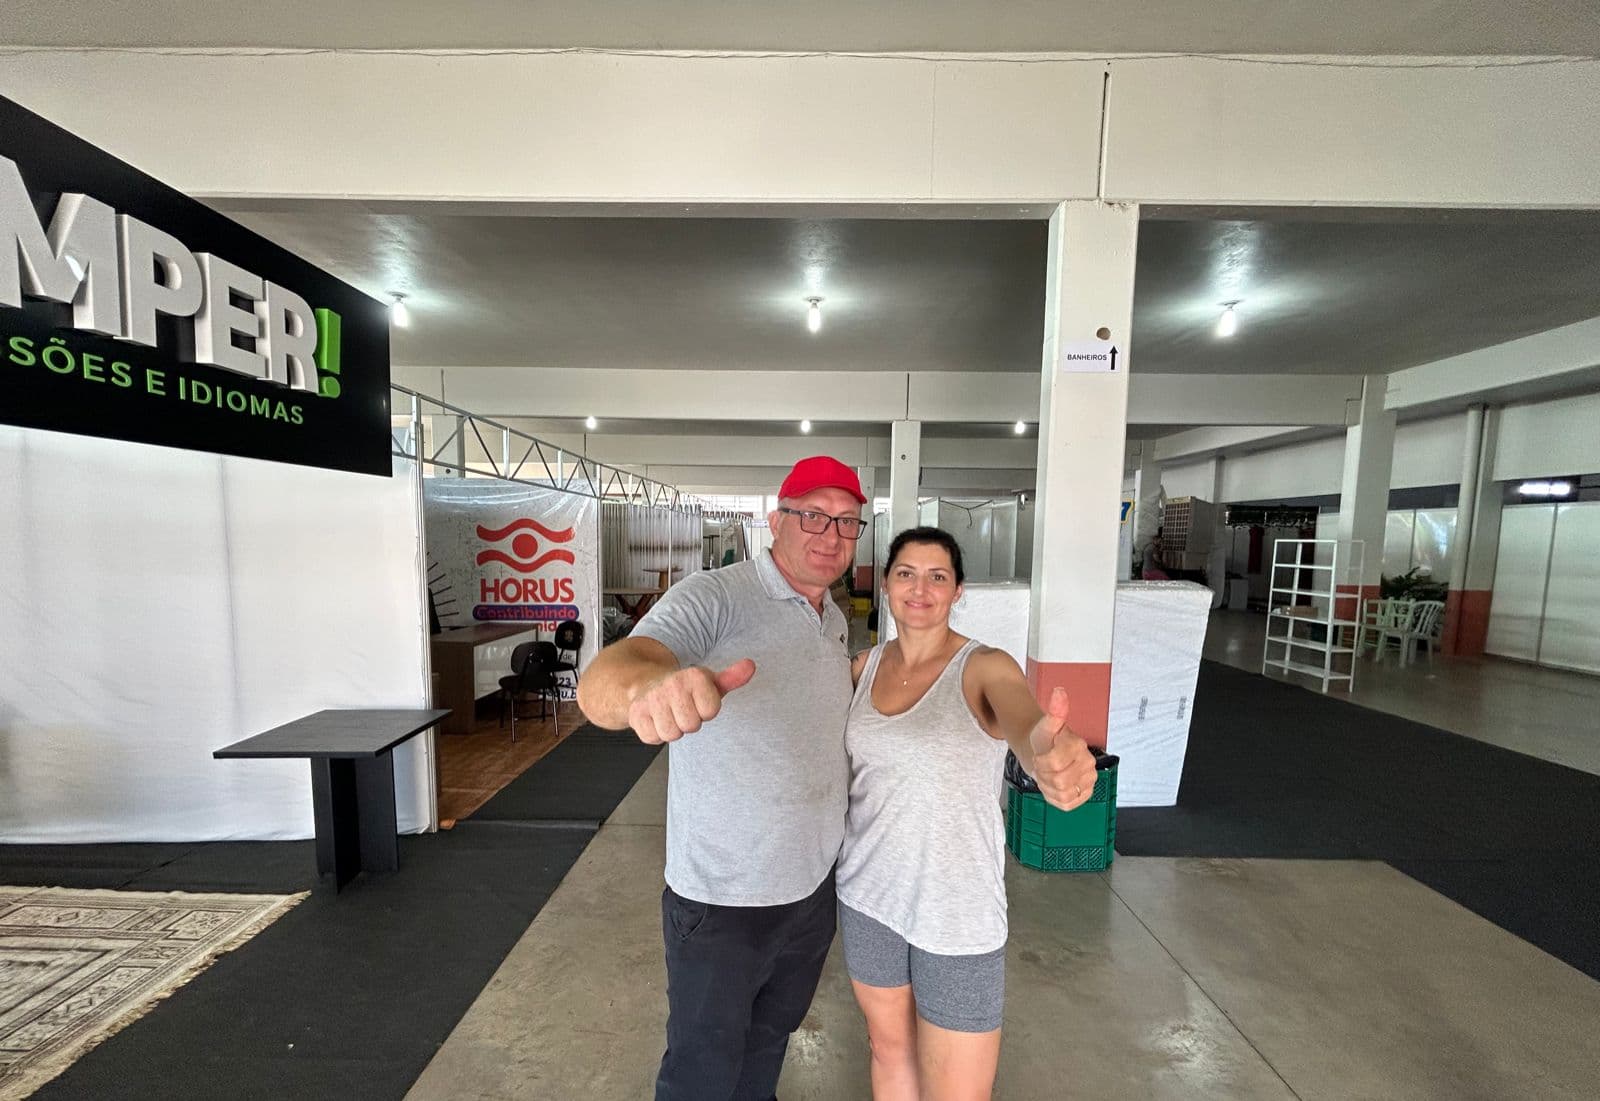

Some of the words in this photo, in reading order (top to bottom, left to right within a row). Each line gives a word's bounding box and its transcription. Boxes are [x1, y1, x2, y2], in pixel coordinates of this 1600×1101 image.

[146, 368, 166, 395] E
[179, 376, 304, 424] IDIOMAS
[480, 578, 574, 602] HORUS
[477, 606, 577, 619] Contribuindo
